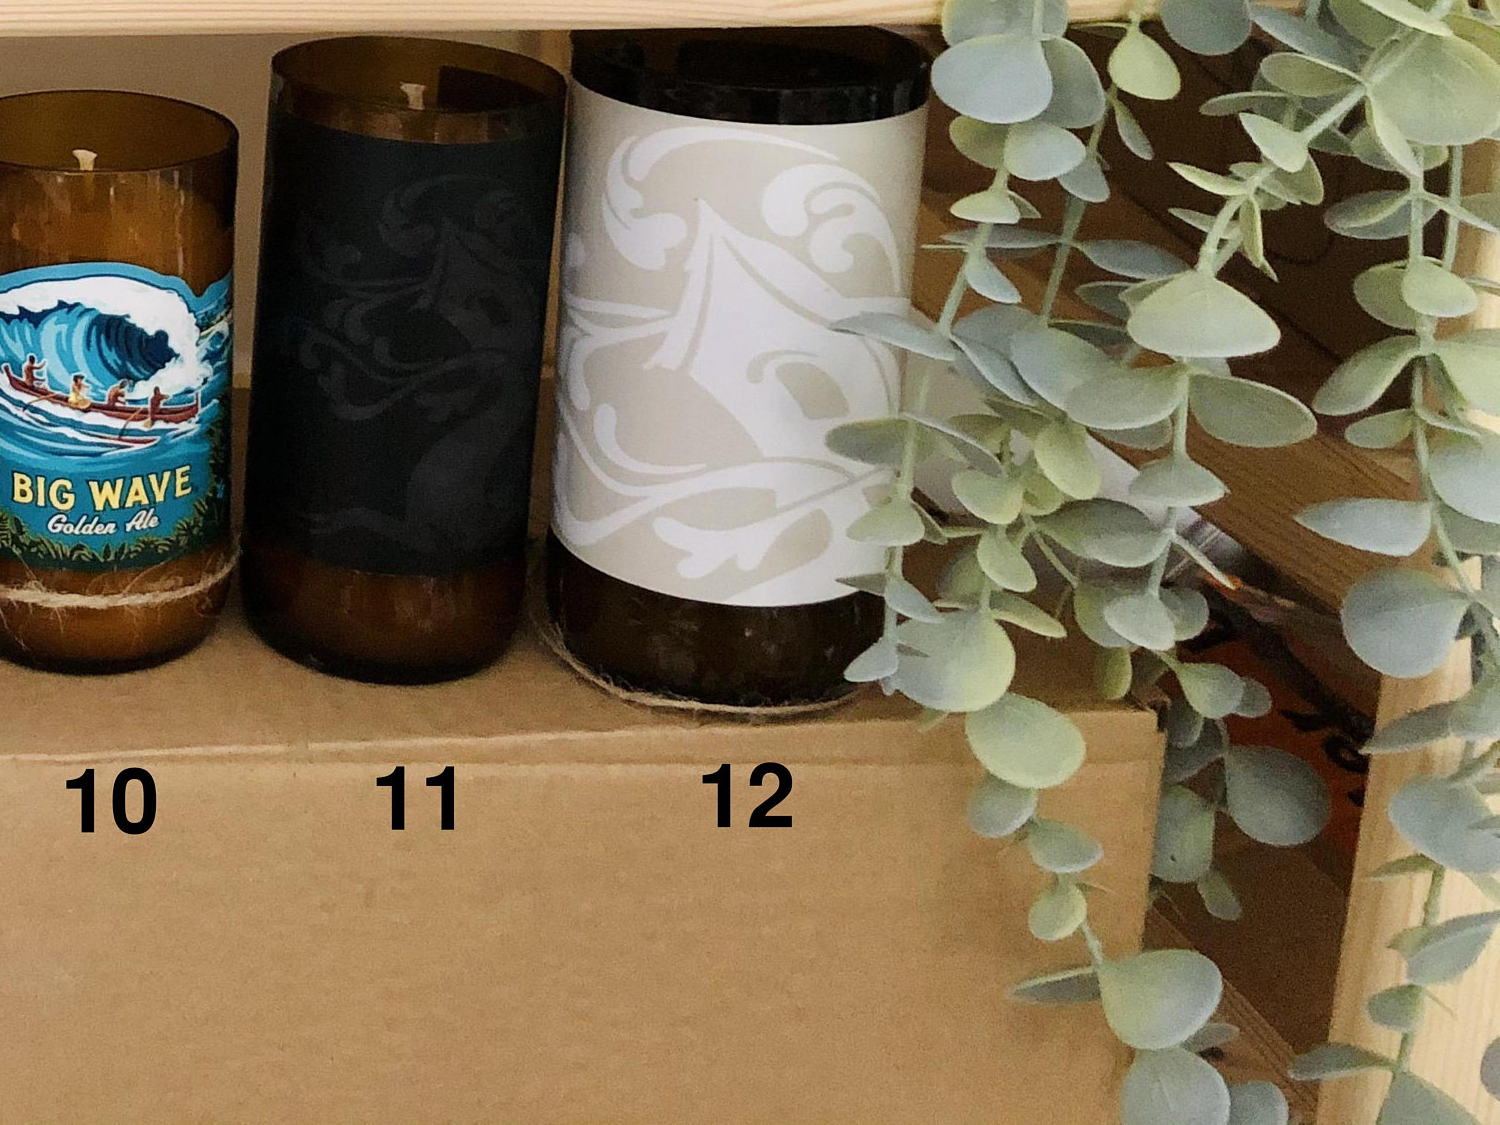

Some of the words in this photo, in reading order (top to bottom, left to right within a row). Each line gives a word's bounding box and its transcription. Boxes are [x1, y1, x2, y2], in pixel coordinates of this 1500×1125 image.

[12, 471, 76, 511] BIG
[87, 465, 193, 511] WAVE
[47, 513, 117, 535] Golden
[125, 509, 161, 533] Ale
